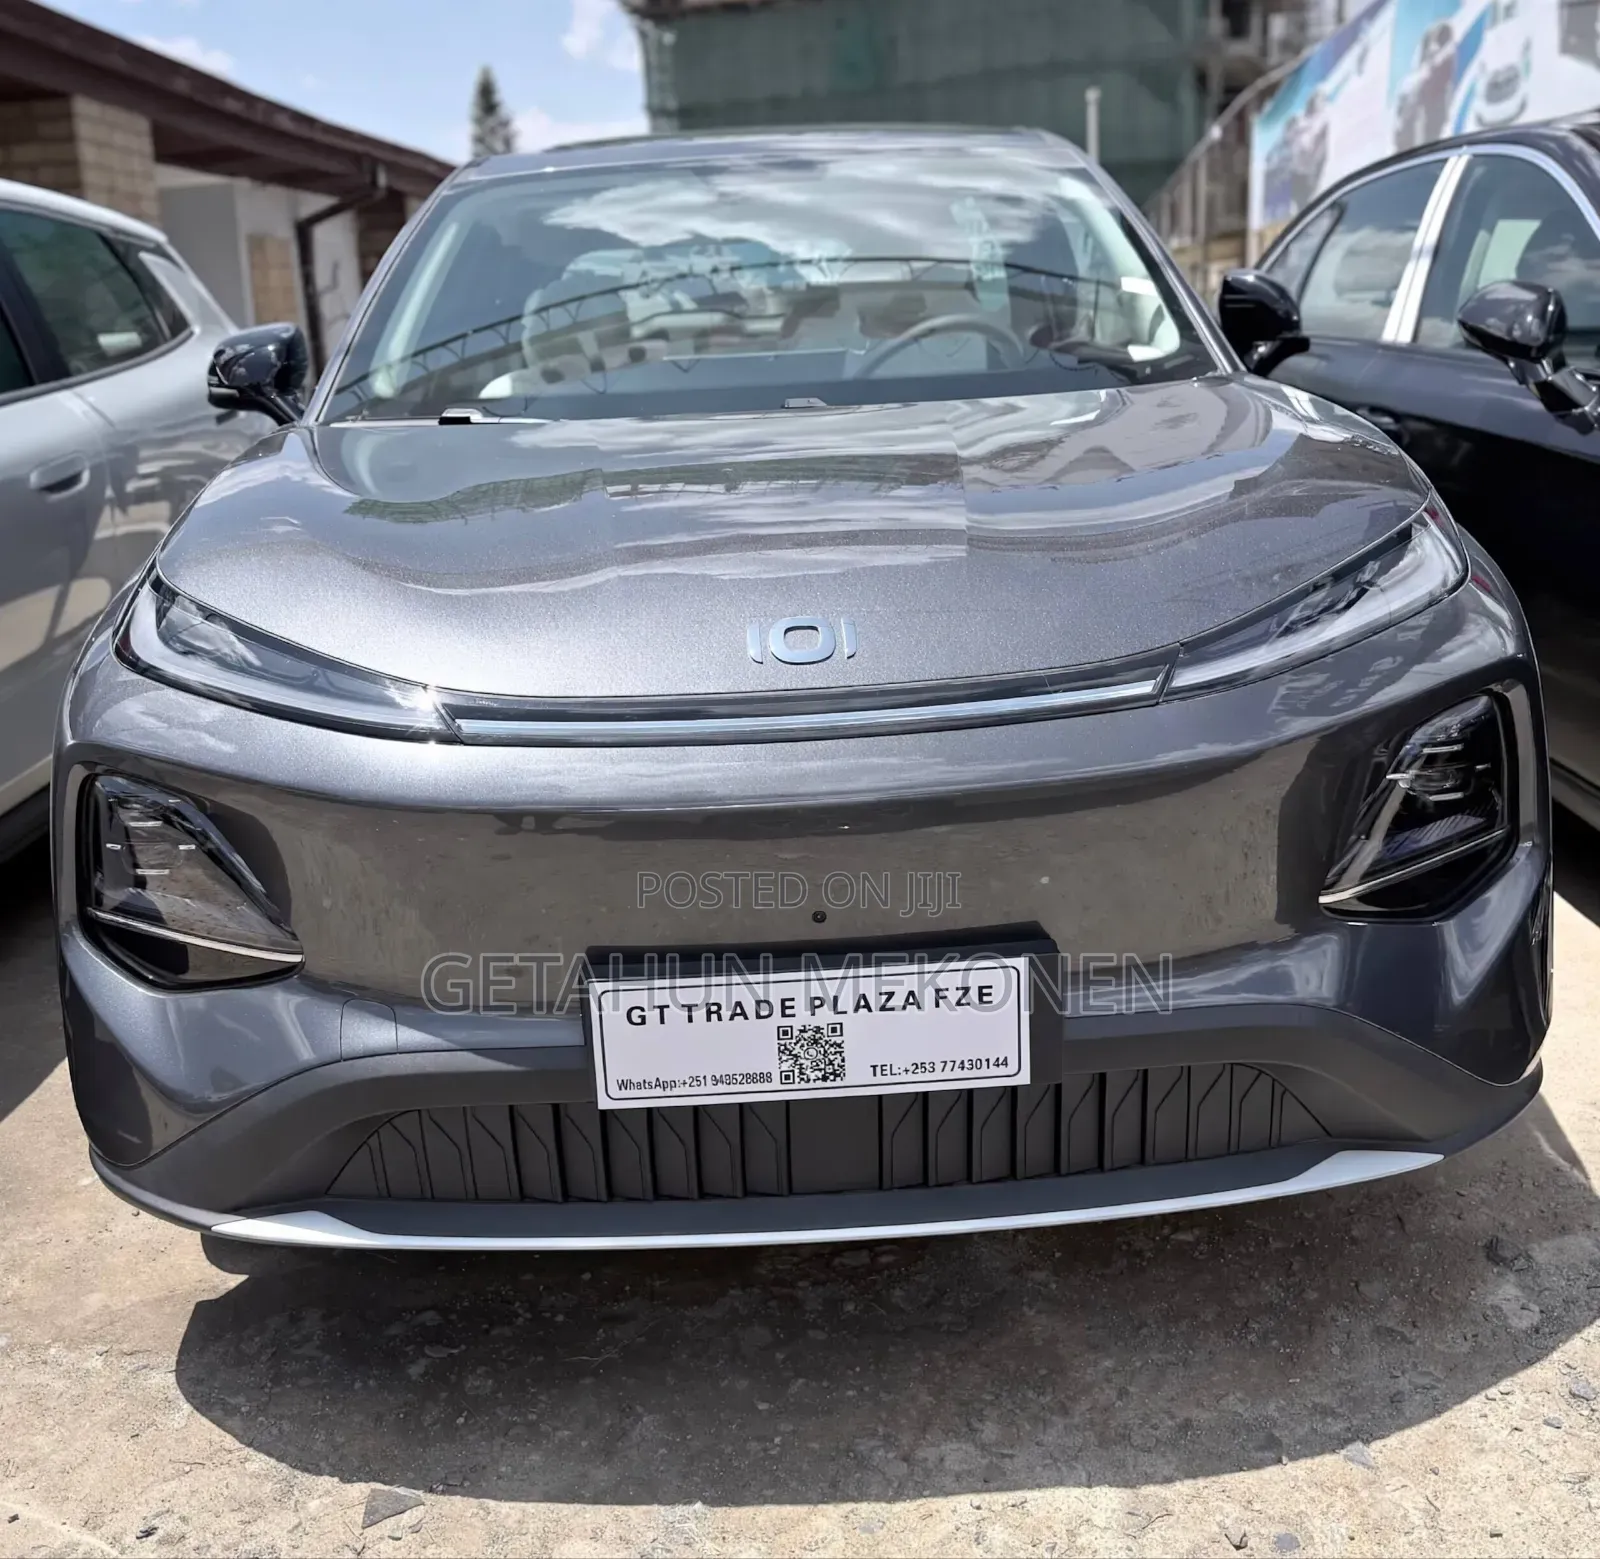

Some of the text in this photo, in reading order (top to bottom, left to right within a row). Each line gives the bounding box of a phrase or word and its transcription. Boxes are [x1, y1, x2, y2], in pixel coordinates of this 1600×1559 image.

[626, 984, 994, 1026] GT TRADE PLAZA FZE
[870, 1056, 1009, 1078] TEL:+253 77430144
